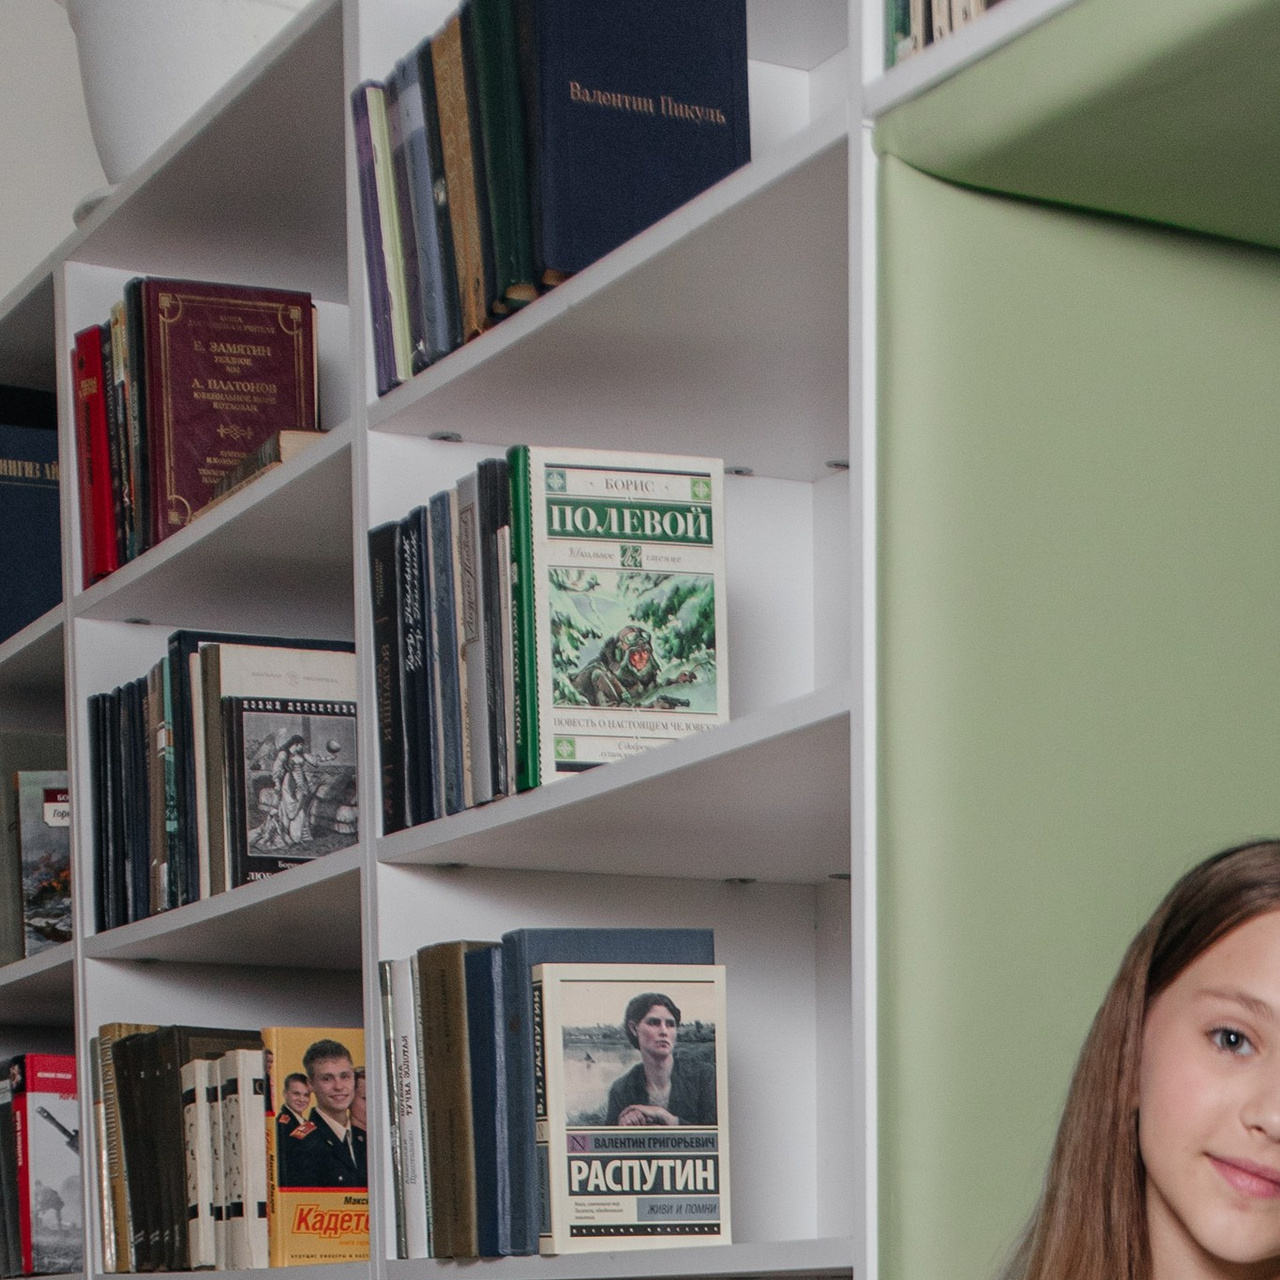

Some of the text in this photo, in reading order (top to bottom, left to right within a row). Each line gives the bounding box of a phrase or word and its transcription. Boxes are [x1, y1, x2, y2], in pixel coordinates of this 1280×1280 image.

[569, 80, 726, 125] Валентин Пикуль
[604, 477, 655, 493] БОРИС
[550, 504, 710, 540] ПОЛЕВОЙ
[553, 717, 597, 729] ПОВЕСТЬ
[598, 720, 607, 728] О
[533, 990, 542, 1079] РАСПУТИН
[594, 1136, 715, 1149] ВАЛЕНТИН ГРИГОРЬЕВИЧ
[570, 1159, 715, 1192] РАСПУТИН
[647, 1203, 717, 1216] ЖИВИ И ПОМНИ
